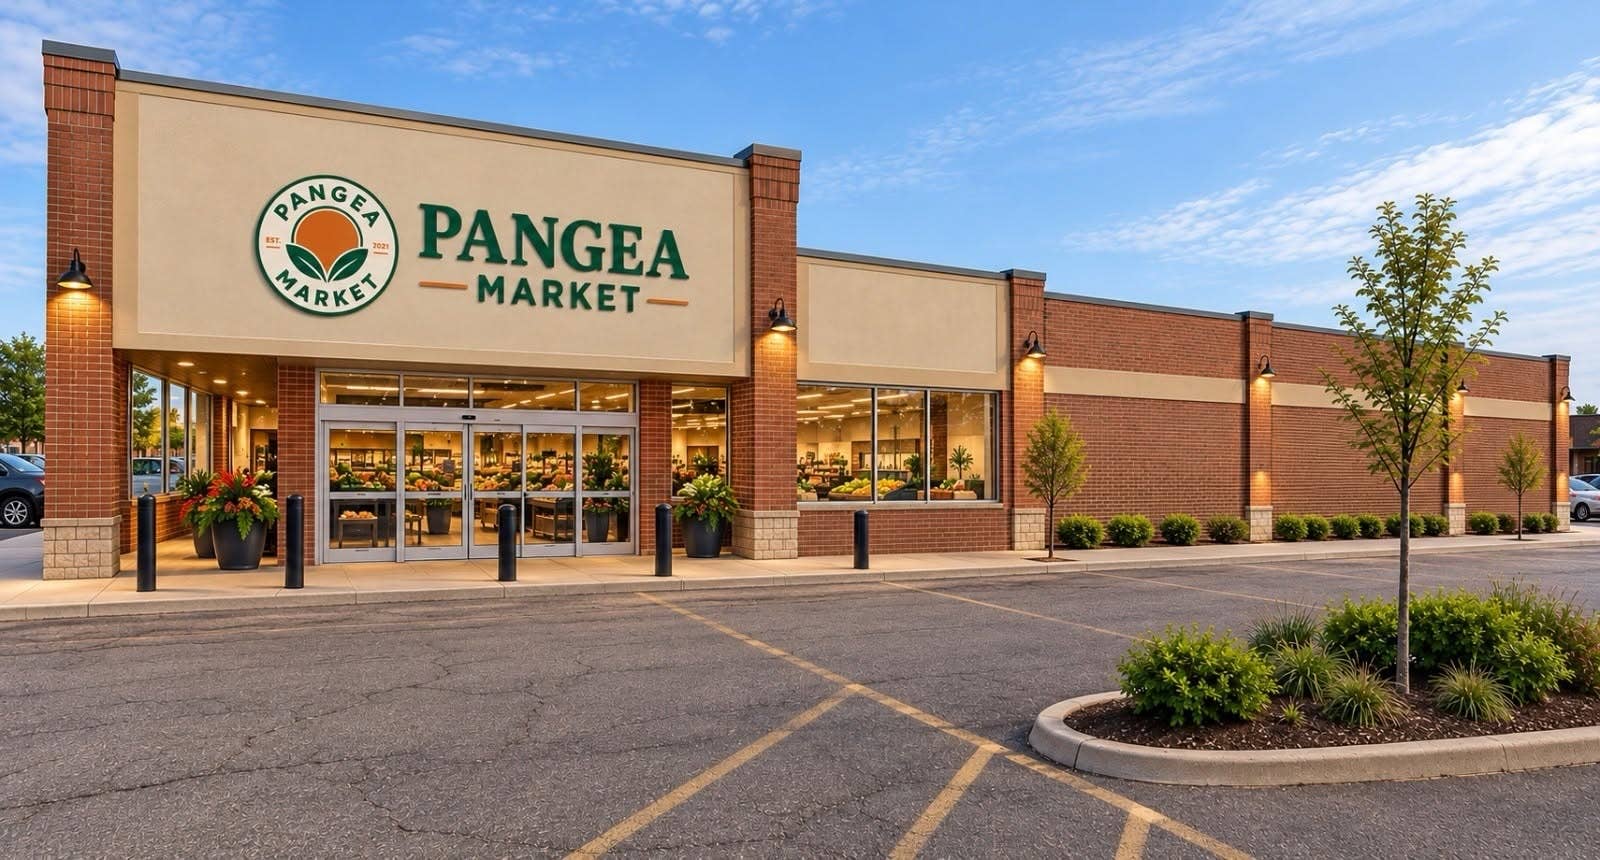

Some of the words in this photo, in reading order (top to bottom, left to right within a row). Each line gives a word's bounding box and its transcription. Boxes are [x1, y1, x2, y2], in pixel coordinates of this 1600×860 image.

[273, 184, 380, 228] PANGEA
[372, 242, 389, 250] 2021
[419, 203, 690, 280] PANGEA
[275, 269, 377, 307] MARKET
[477, 274, 641, 313] MARKET
